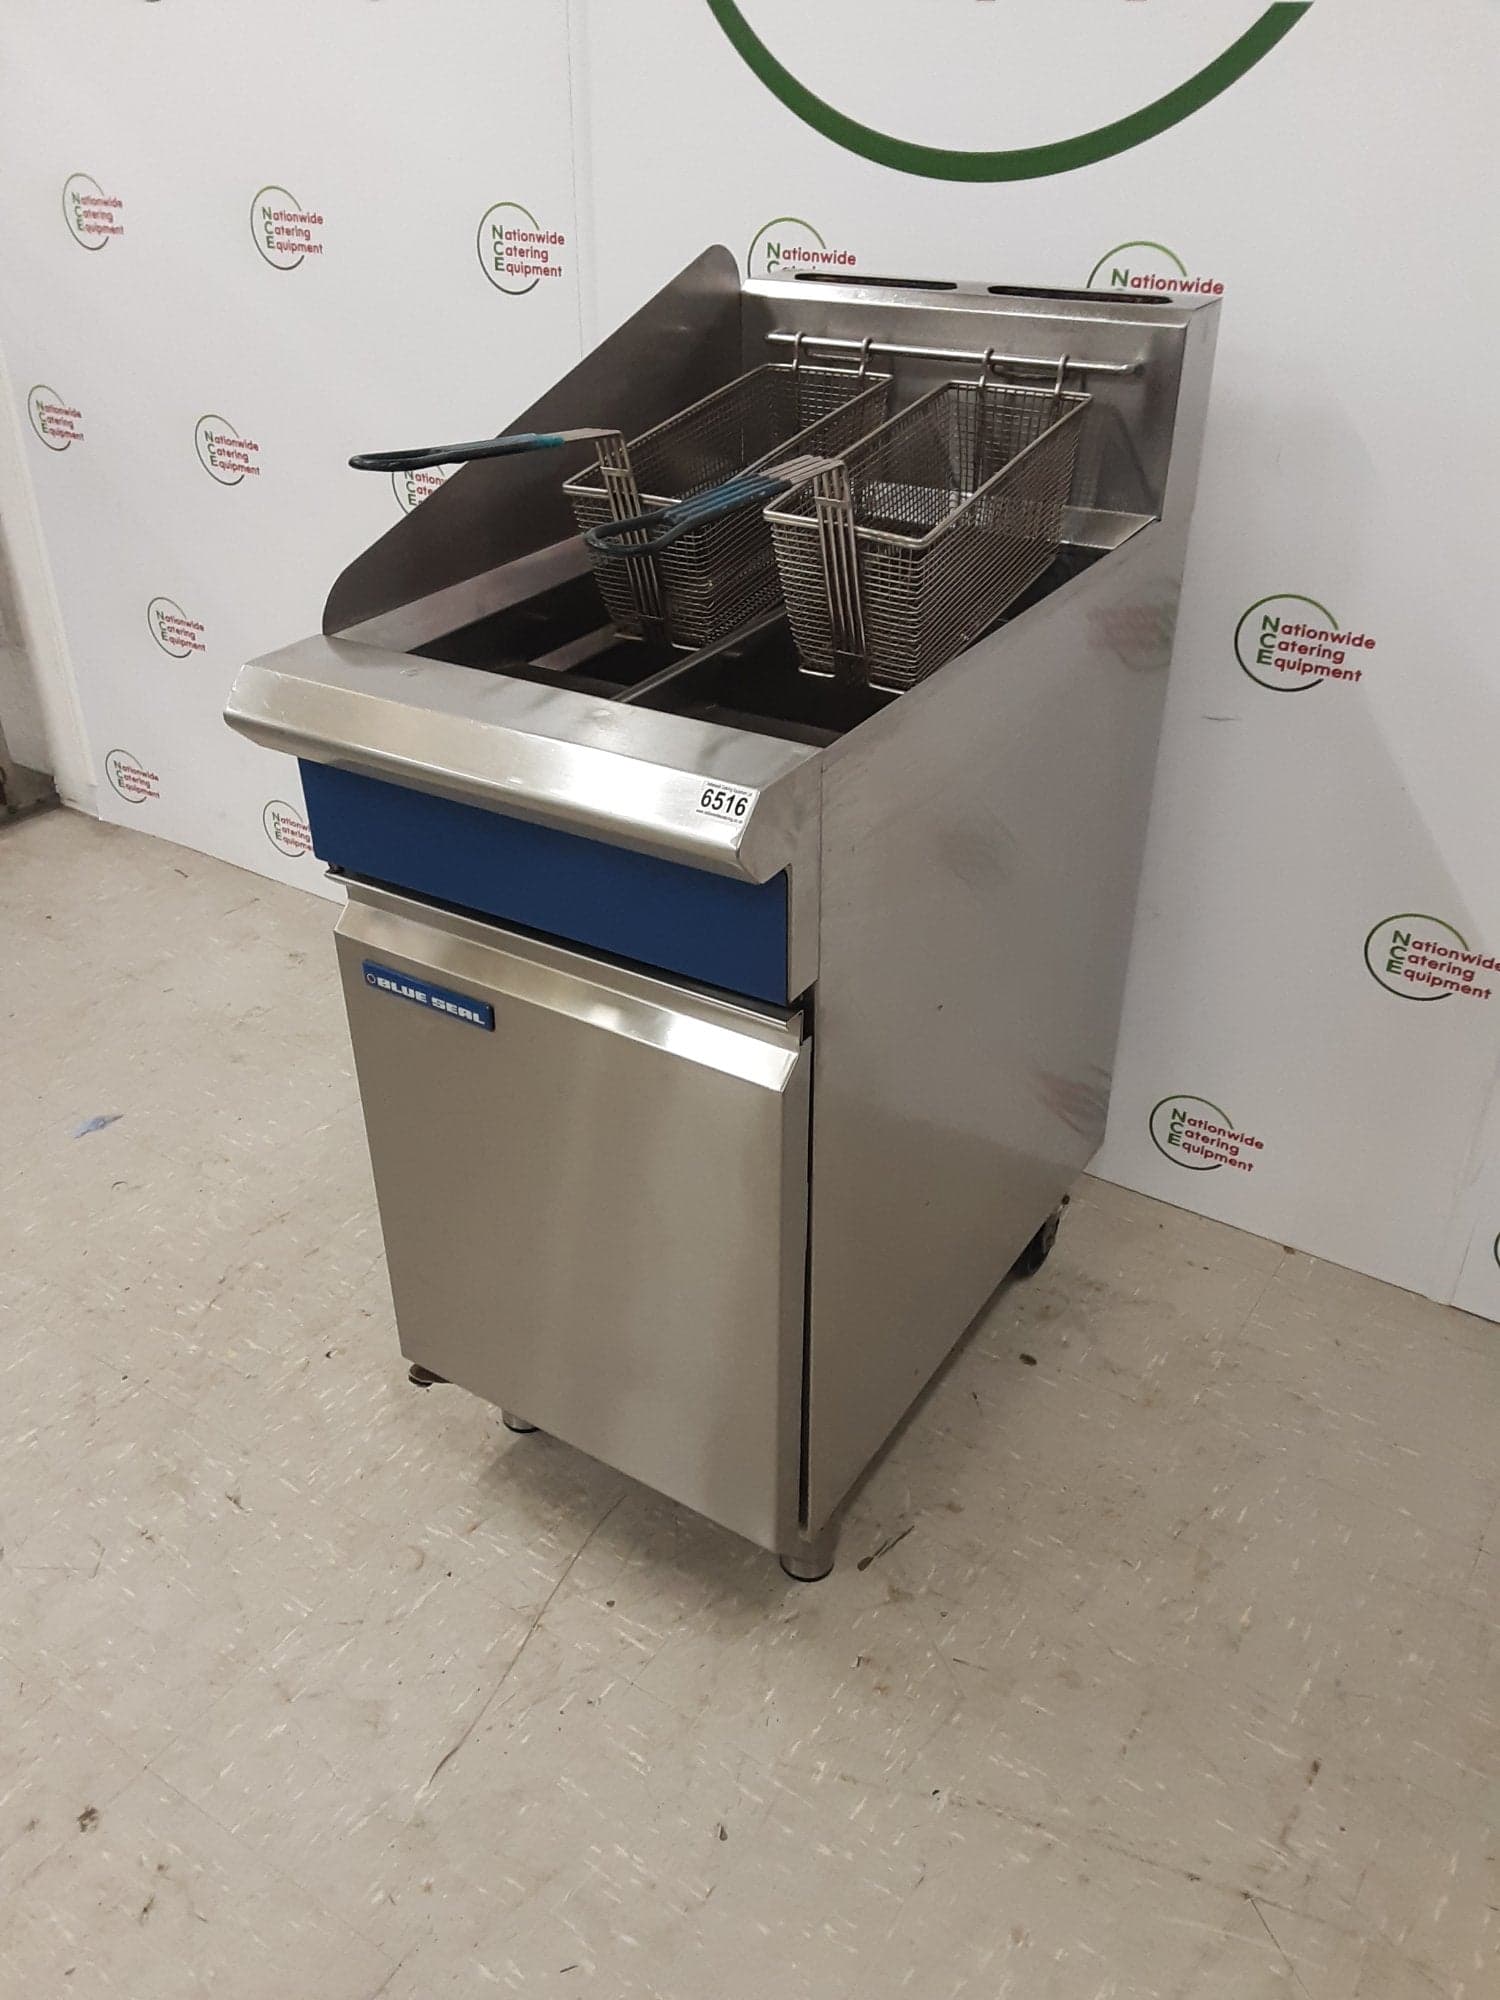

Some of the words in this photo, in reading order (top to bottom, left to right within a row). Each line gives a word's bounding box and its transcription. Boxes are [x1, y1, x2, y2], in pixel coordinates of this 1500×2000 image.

[262, 206, 324, 225] Nationwide
[264, 220, 311, 241] Catering
[492, 224, 565, 245] Nationwide
[266, 235, 323, 254] Equipment
[493, 241, 549, 263] Catering
[766, 241, 857, 266] Nationwide
[494, 256, 562, 277] Equipment
[1111, 267, 1225, 295] Nationwide
[204, 430, 259, 451] Nationwide
[207, 443, 249, 464] Catering
[209, 455, 260, 475] Equipment
[404, 470, 443, 486] Nation
[1260, 614, 1376, 650] Nationwide
[1259, 632, 1346, 664] Catering
[1256, 648, 1363, 682] Equipment
[701, 789, 748, 816] 6516
[273, 821, 311, 843] Catering
[1388, 945, 1476, 982] Catering
[1385, 958, 1492, 999] Equipment
[376, 977, 428, 1004] BLUE
[431, 996, 486, 1026] SEAL
[1169, 1121, 1239, 1156] Catering
[1171, 1107, 1264, 1149] Nationwide
[1167, 1131, 1254, 1172] Equipment
